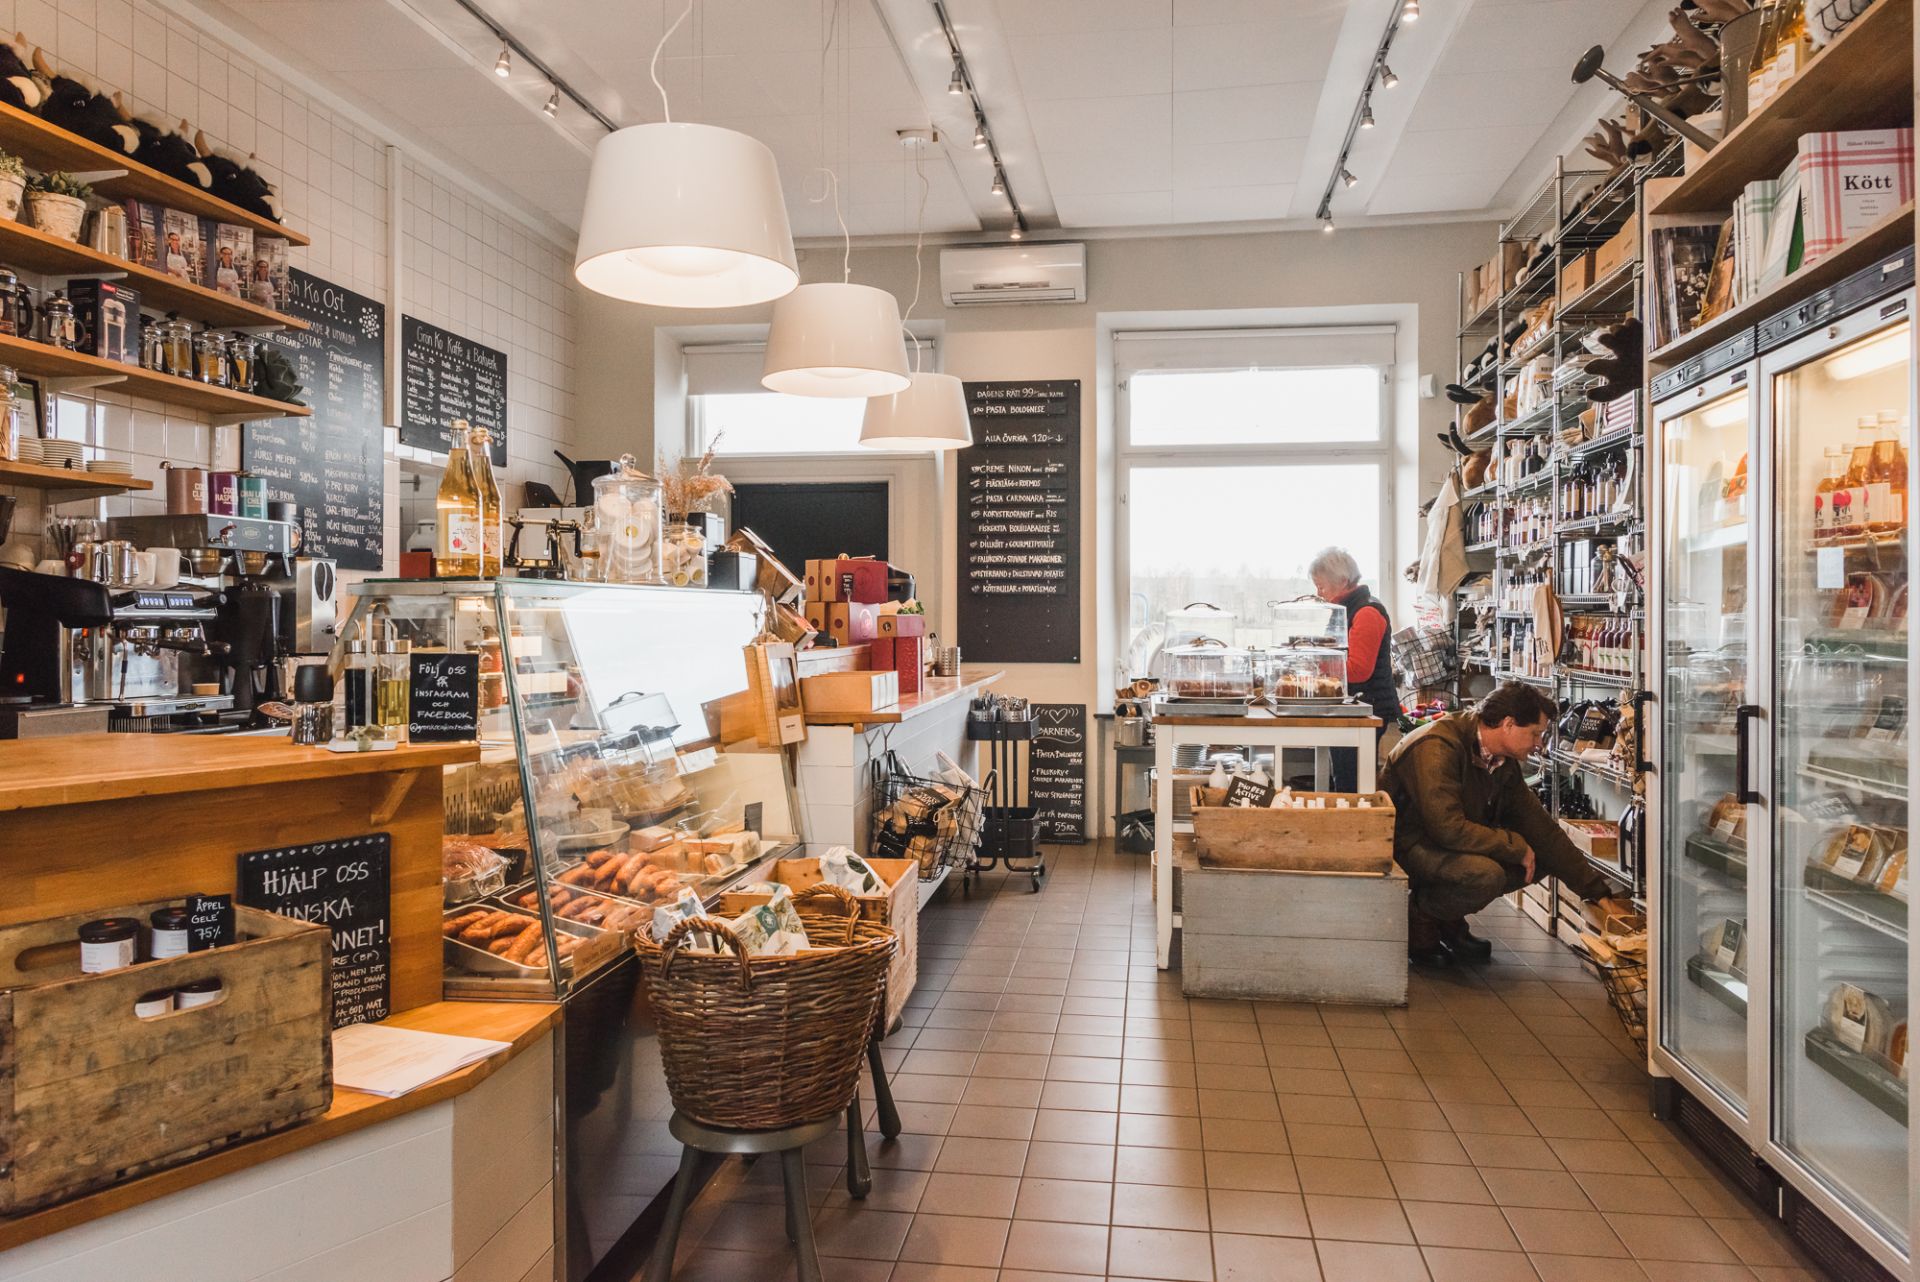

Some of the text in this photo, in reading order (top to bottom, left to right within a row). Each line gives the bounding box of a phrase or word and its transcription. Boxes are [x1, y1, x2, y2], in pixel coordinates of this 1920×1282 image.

[1844, 175, 1892, 190] Kött
[304, 280, 320, 303] Ko
[323, 288, 346, 312] Ost
[298, 332, 323, 349] OSTAR
[977, 390, 1004, 398] DAGENS
[986, 405, 1006, 414] PASTA
[448, 666, 467, 675] OSS
[416, 688, 469, 698] INSTAGRAM
[417, 710, 473, 719] FACEBOOK
[1235, 789, 1260, 800] ACTIVE
[263, 861, 369, 896] HJÄLP OSS
[350, 968, 366, 977] MEN
[370, 964, 384, 973] DET
[349, 1004, 363, 1014] GOD
[366, 999, 382, 1009] MAT
